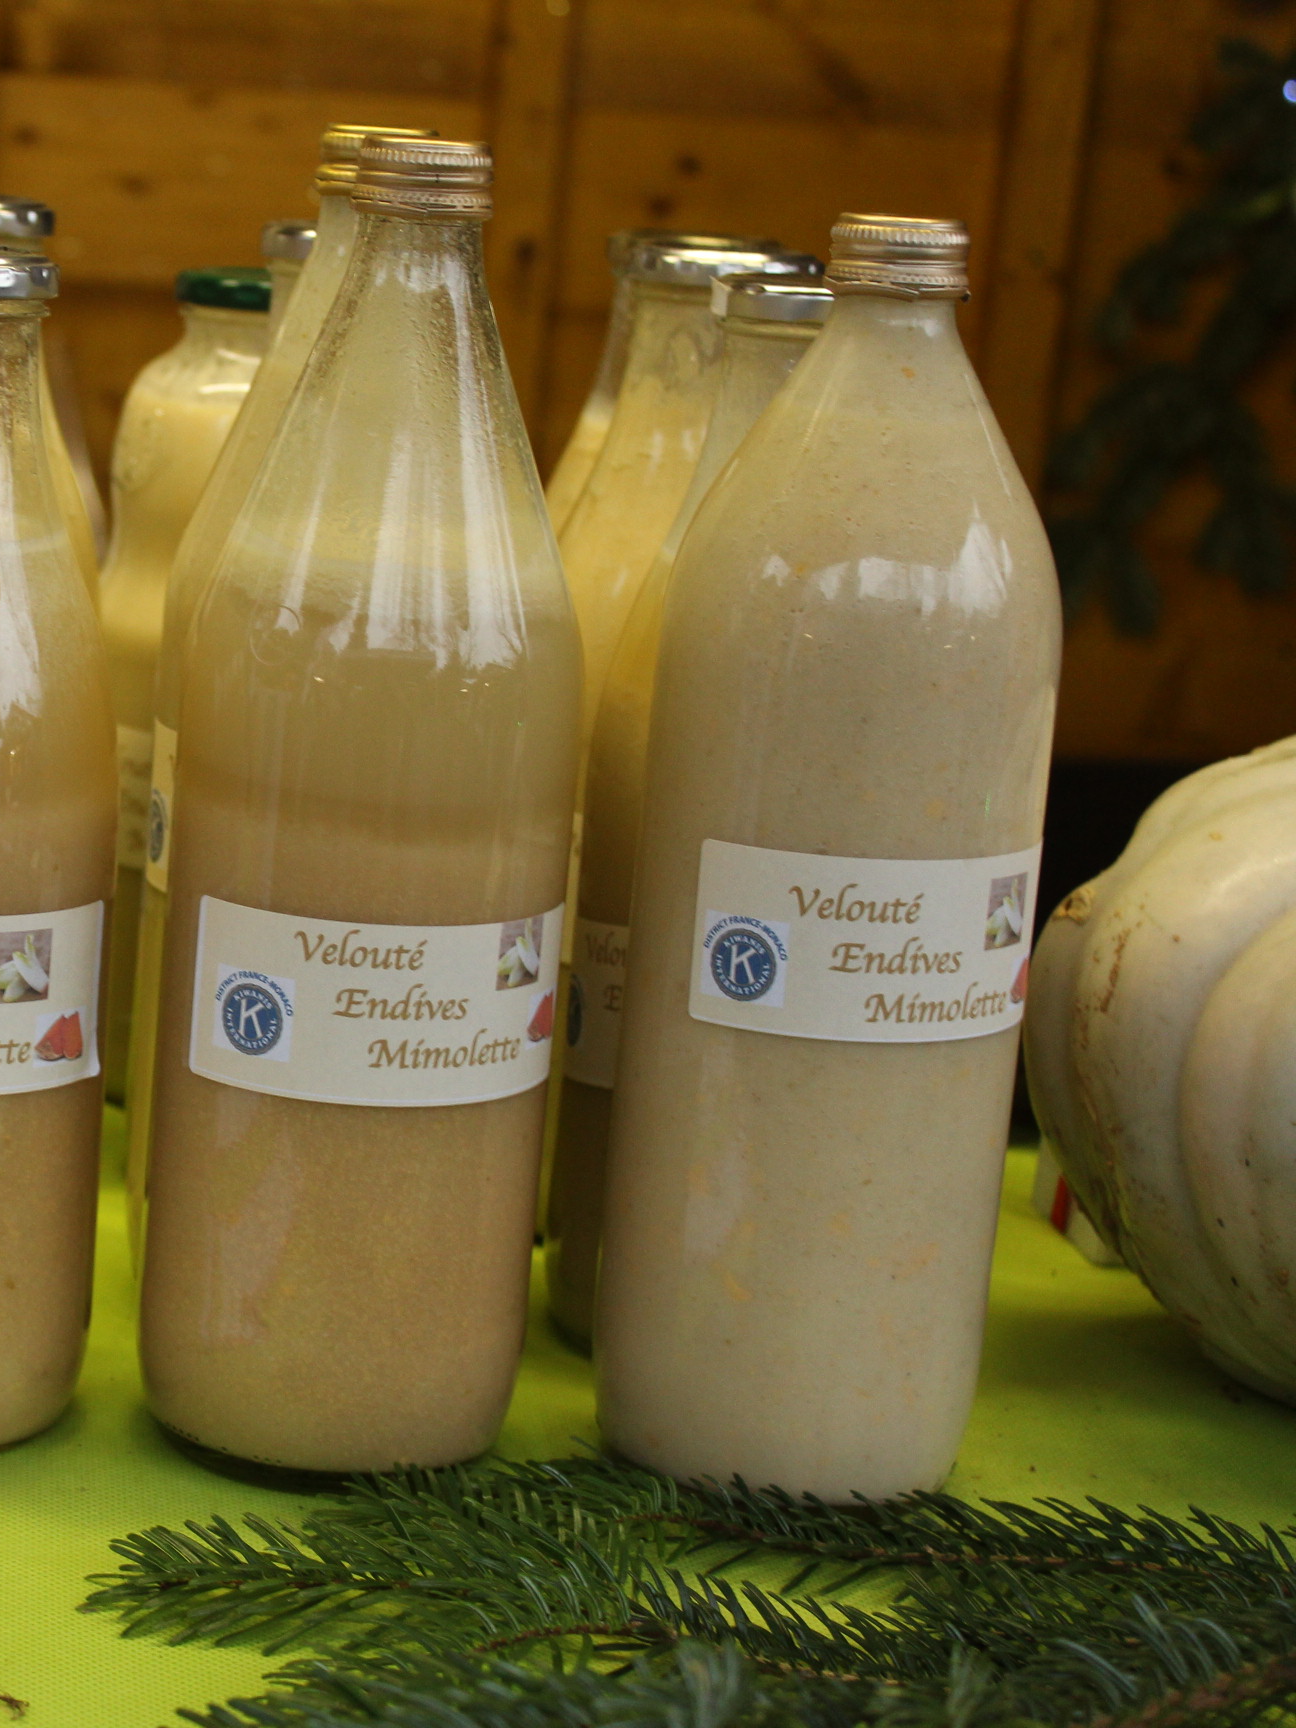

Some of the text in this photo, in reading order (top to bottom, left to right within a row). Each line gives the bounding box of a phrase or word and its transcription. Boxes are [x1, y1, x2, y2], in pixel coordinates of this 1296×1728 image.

[789, 883, 924, 924] Velouté
[294, 929, 428, 970] Velouté
[728, 944, 757, 984] K
[828, 936, 963, 975] Endives
[237, 998, 264, 1039] K
[332, 983, 469, 1021] Endives
[864, 982, 1007, 1023] Mimolette
[368, 1028, 521, 1069] Mimolette
